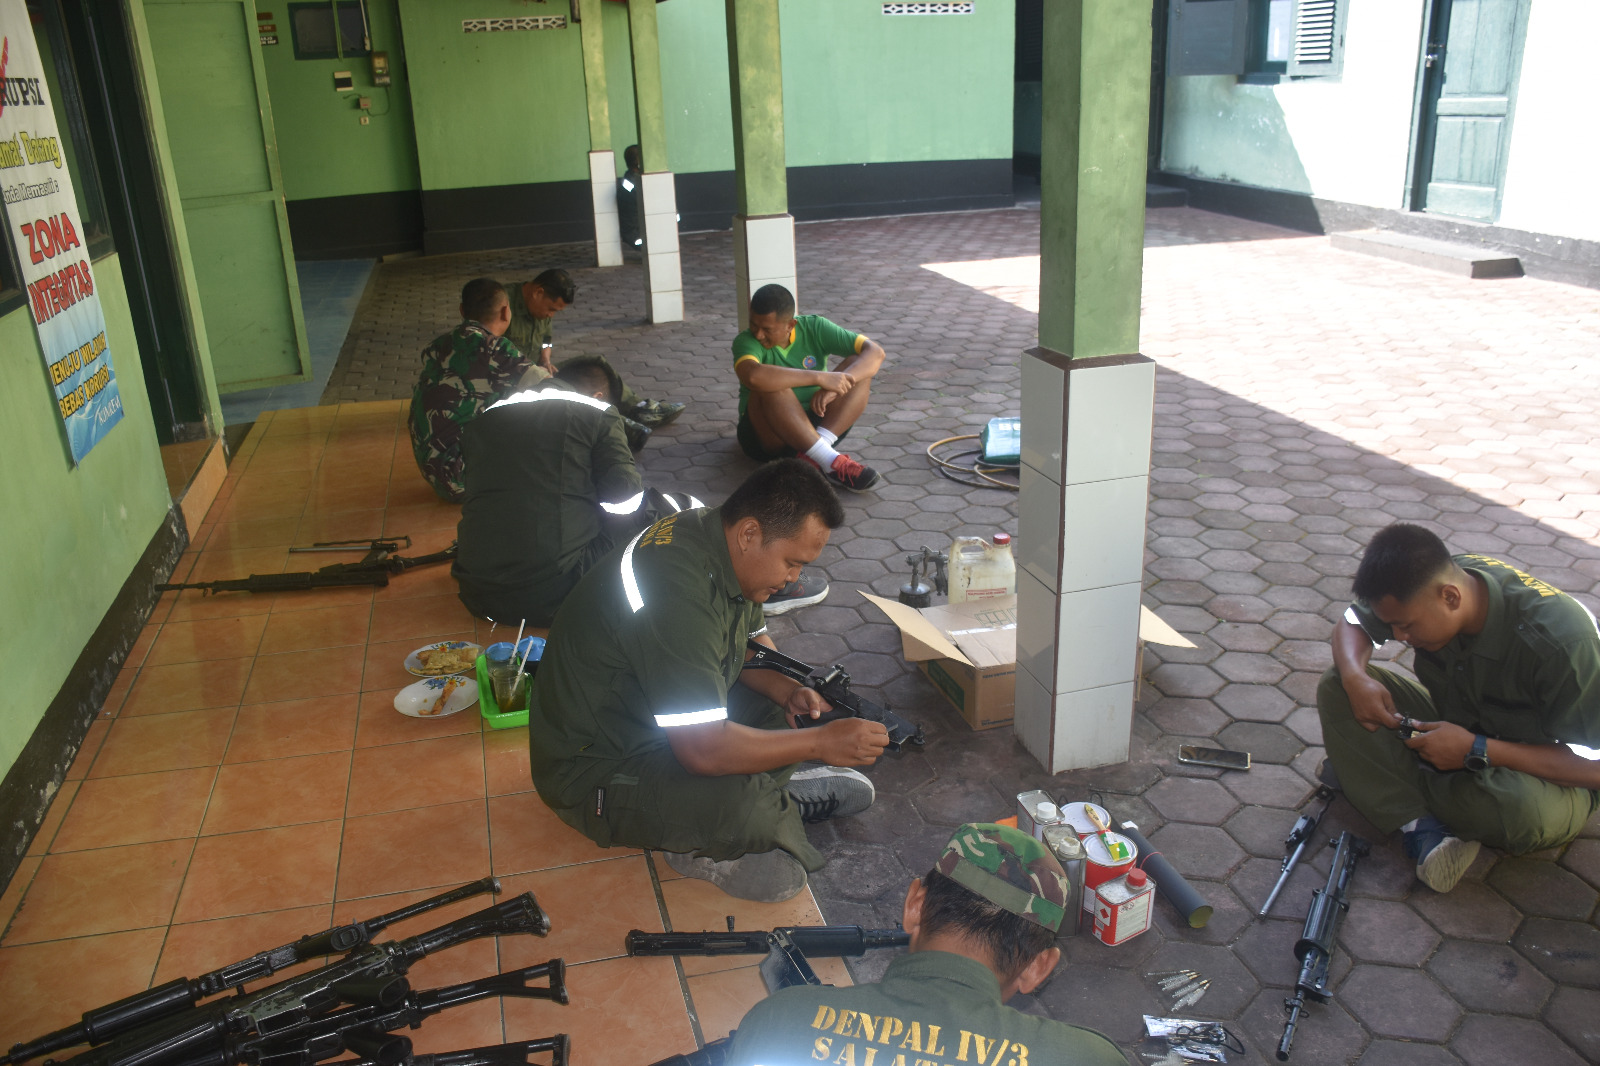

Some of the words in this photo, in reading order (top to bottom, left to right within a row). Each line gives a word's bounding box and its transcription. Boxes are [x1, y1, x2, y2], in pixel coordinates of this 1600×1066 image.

[19, 130, 62, 169] Datang
[20, 212, 80, 265] ZONA
[27, 260, 94, 325] INTEGRITAS
[59, 385, 85, 420] BEBAS
[83, 363, 110, 402] KORUPSI
[810, 1005, 945, 1056] DENPAL
[956, 1029, 1029, 1066] IV/3
